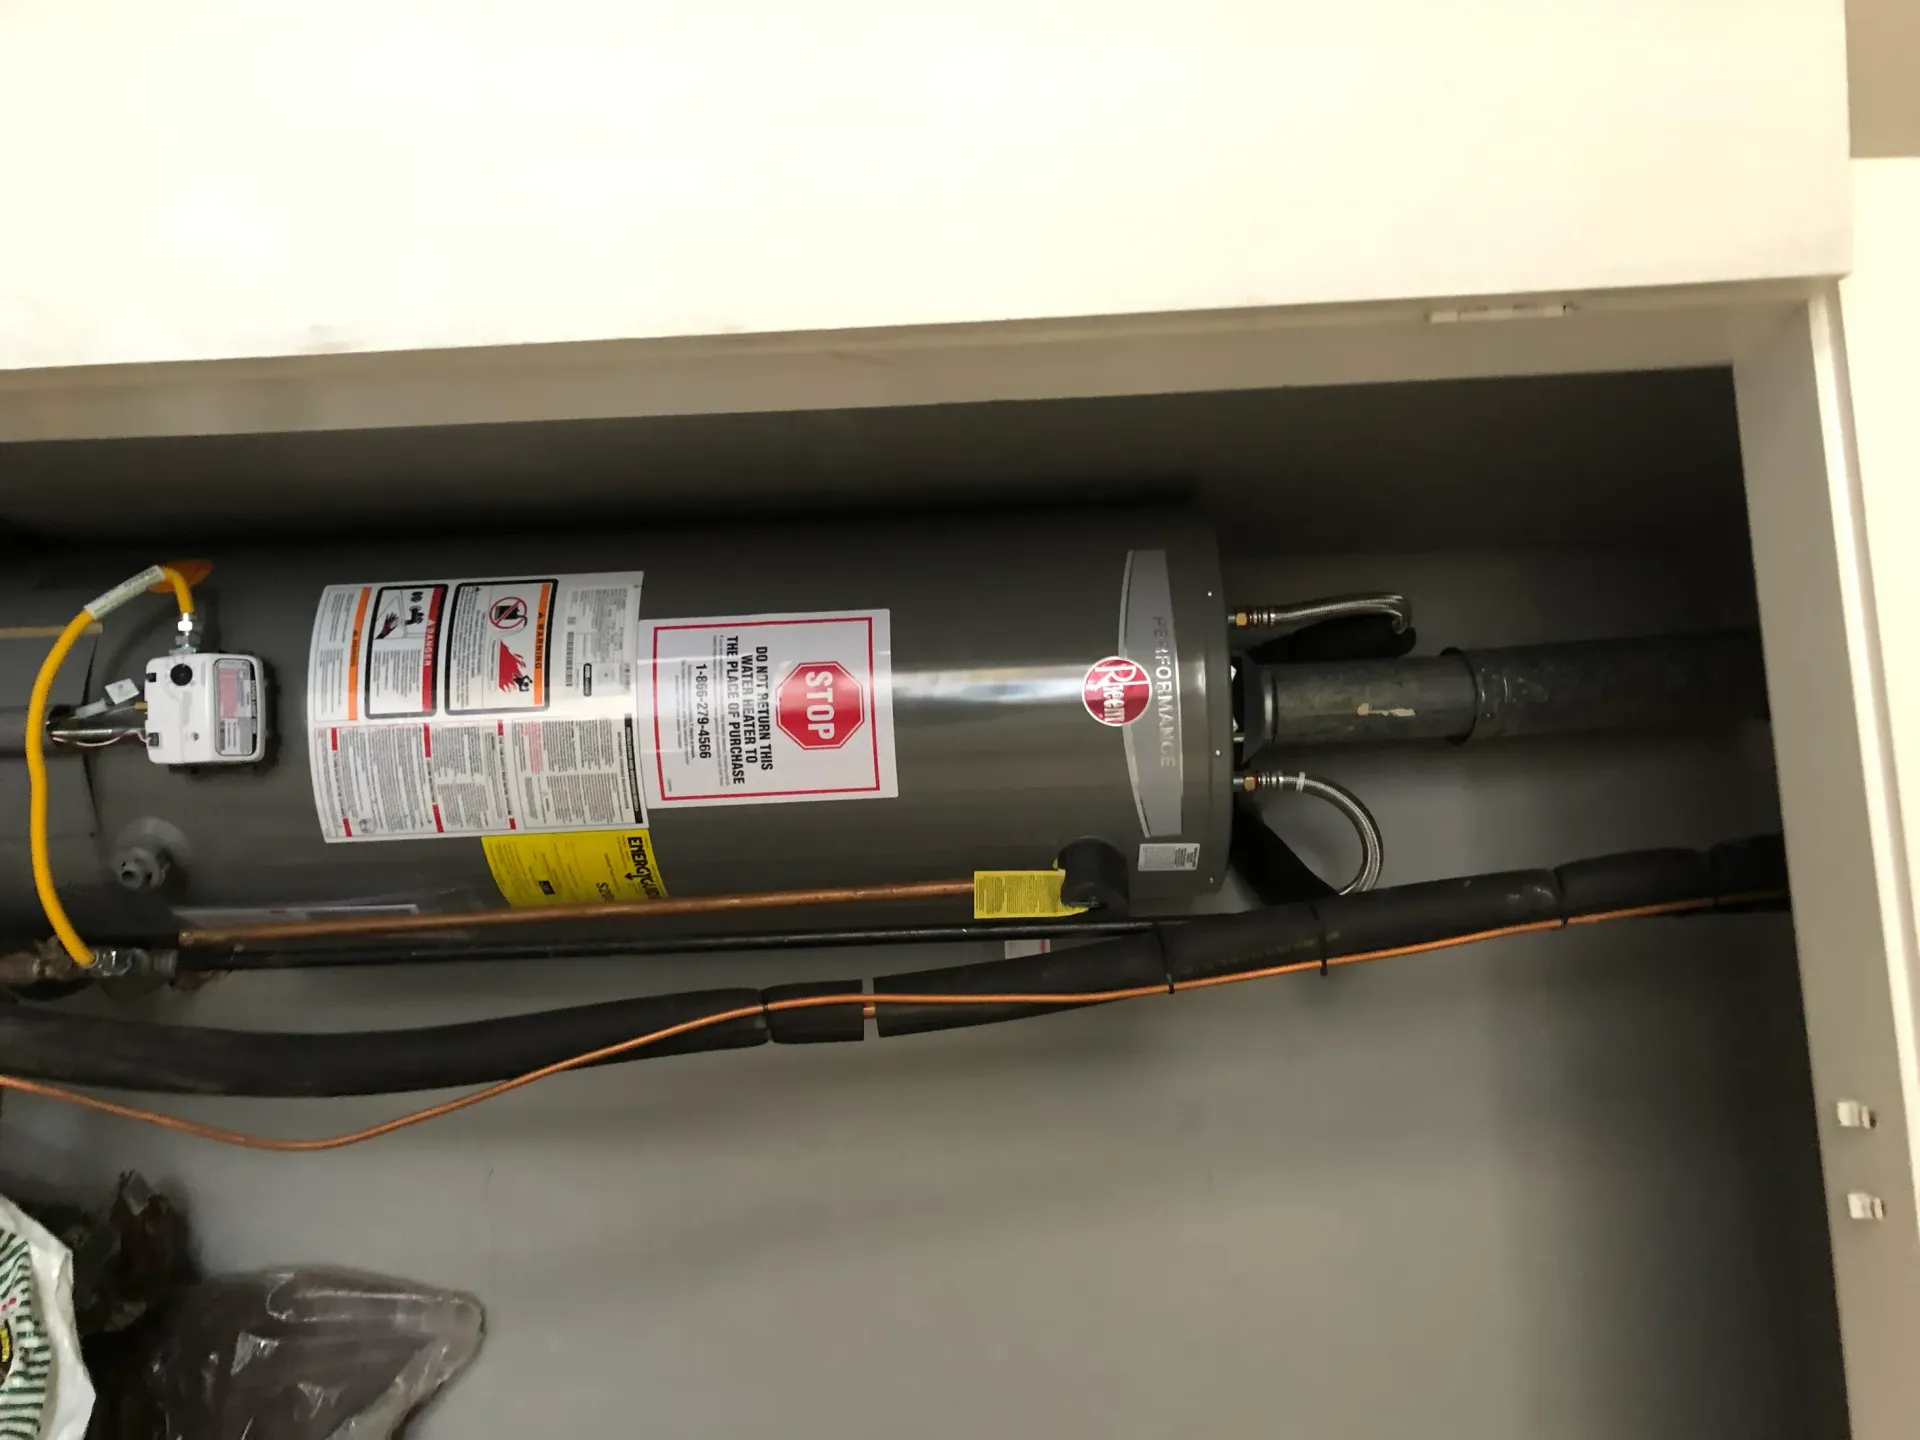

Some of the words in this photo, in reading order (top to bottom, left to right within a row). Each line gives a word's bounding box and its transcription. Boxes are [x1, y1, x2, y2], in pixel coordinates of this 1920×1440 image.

[424, 628, 434, 666] DANGER
[535, 624, 543, 669] WARNING
[726, 636, 738, 656] THE
[756, 646, 768, 661] DO
[726, 661, 740, 698] PLACE
[741, 655, 754, 696] WATER
[756, 666, 768, 688] NOT
[1091, 664, 1148, 722] Rheem
[1152, 617, 1175, 768] PERFORMANCE
[695, 664, 711, 759] 1-866-279-4566
[728, 703, 740, 718] OF
[742, 700, 756, 744] HEATER
[757, 692, 771, 740] RETURN
[804, 671, 835, 740] STOP
[728, 722, 745, 784] PURCHASE
[745, 749, 758, 763] TO
[760, 744, 773, 770] THIS
